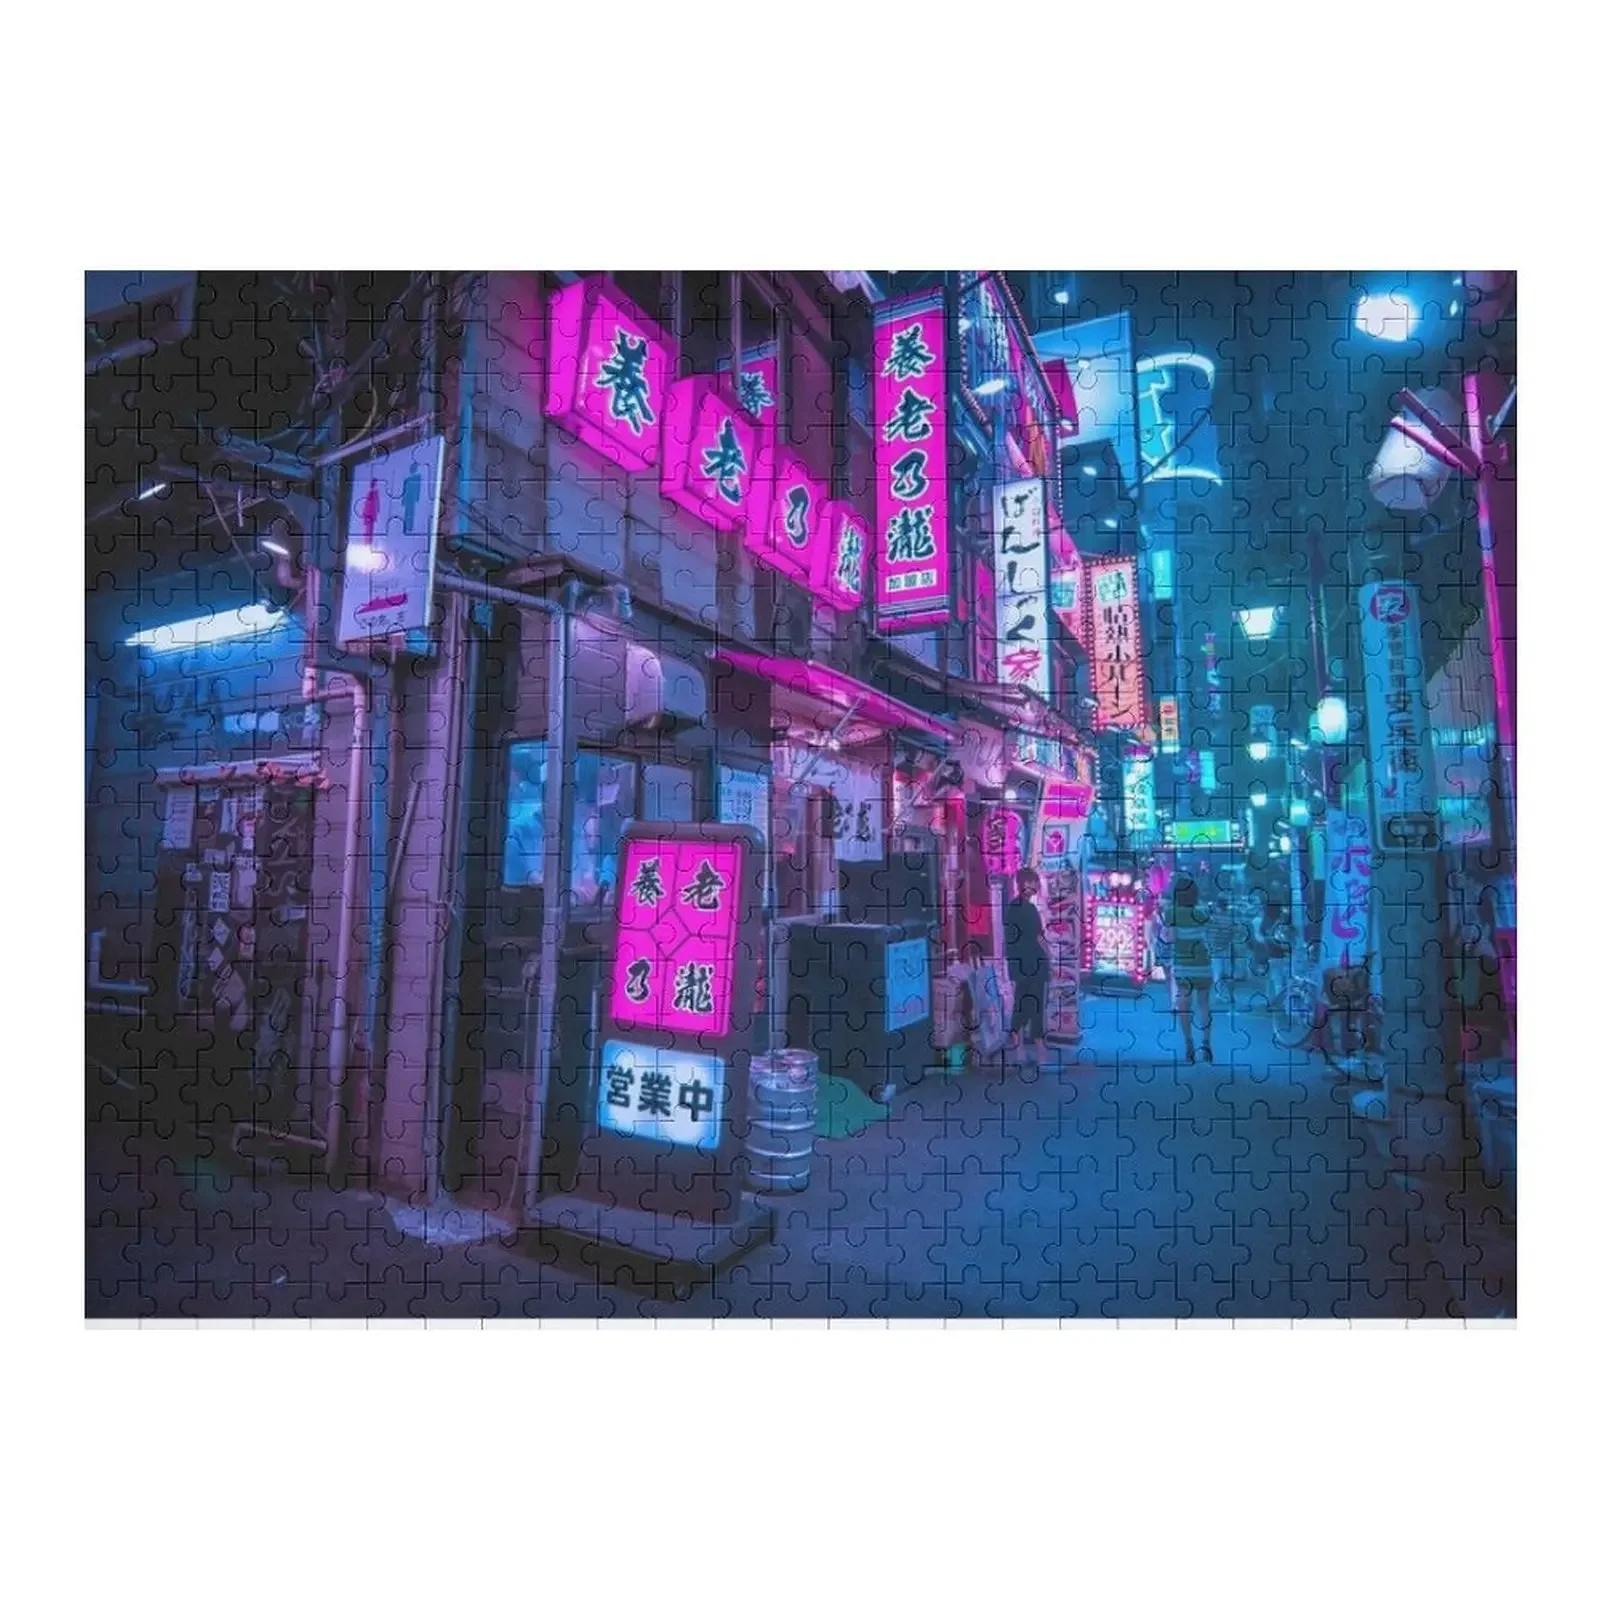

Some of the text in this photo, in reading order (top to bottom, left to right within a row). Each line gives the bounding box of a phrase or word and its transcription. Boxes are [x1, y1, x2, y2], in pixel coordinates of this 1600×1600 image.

[596, 326, 655, 436] 養
[700, 416, 748, 506] 老
[880, 323, 938, 563] 養老乃瀧
[604, 1064, 715, 1122] 営業中
